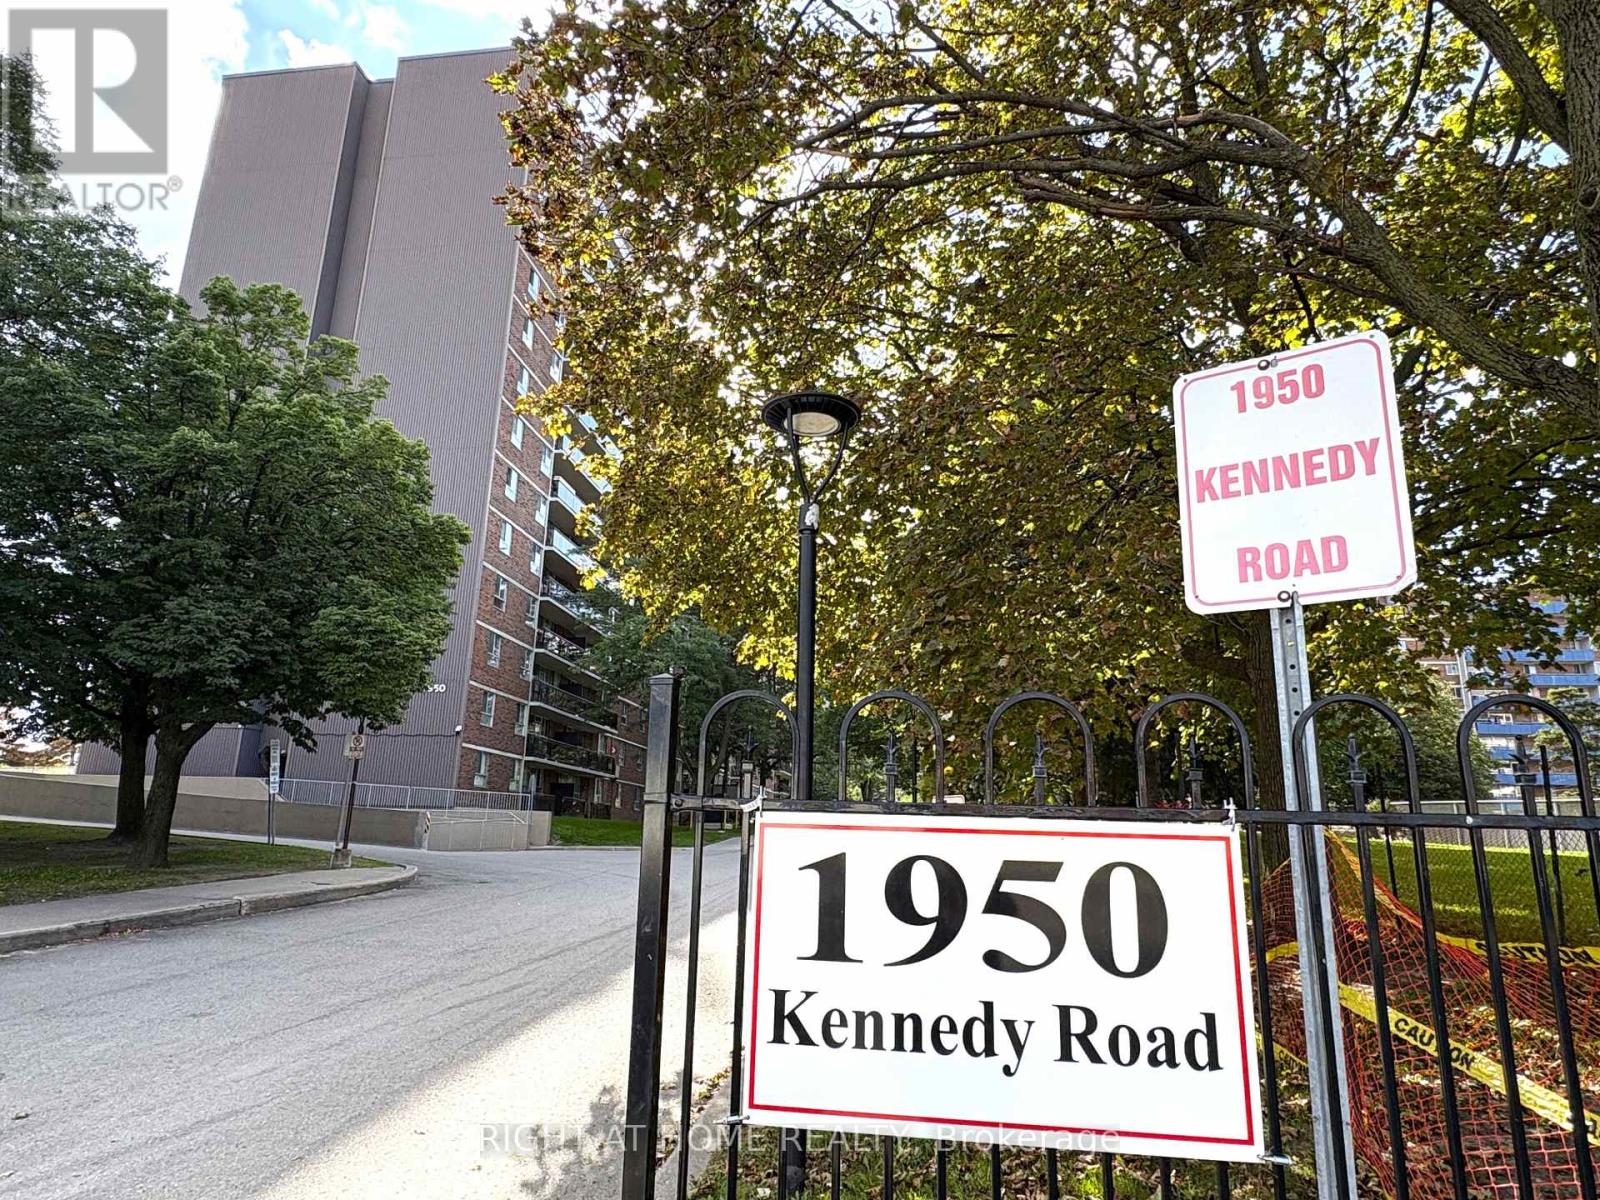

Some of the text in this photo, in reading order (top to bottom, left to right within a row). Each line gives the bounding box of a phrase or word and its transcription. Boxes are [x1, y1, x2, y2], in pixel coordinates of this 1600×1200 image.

[1230, 363, 1326, 414] 1950
[1194, 436, 1380, 504] KENNEDY
[1236, 534, 1349, 583] ROAD
[797, 851, 1168, 979] 1950
[766, 988, 1223, 1078] Kennedy Road
[1394, 1018, 1475, 1071] CAUON
